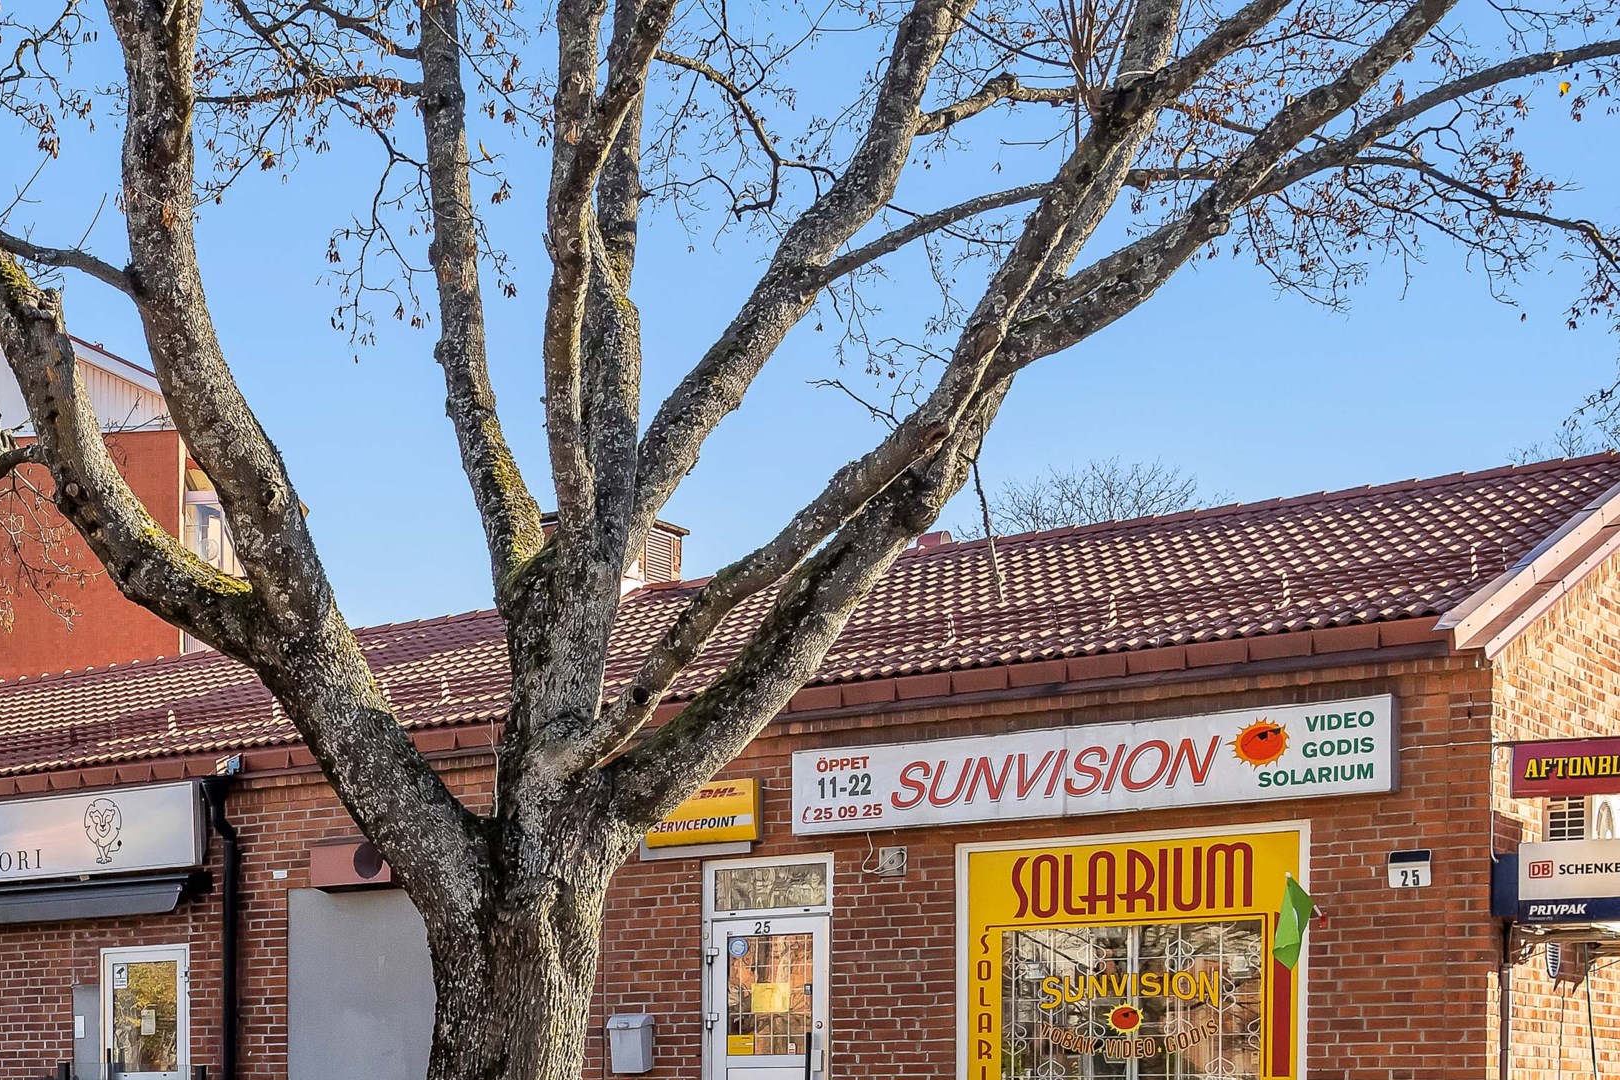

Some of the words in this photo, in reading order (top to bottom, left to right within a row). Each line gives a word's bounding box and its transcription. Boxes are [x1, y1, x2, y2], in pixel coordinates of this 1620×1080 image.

[1305, 710, 1375, 733] VIDEO
[1302, 736, 1375, 759] GODIS
[816, 755, 870, 773] ÖPPET
[890, 735, 1222, 811] SUNVISION
[1258, 762, 1374, 788] SOLARIUM
[1524, 755, 1620, 779] AFTONBL
[699, 786, 738, 800] DHL
[817, 772, 872, 799] 11-22
[813, 806, 833, 821] 25
[837, 804, 858, 820] 09
[862, 802, 883, 817] 25
[652, 815, 738, 834] SERVICEPOINT
[1010, 841, 1253, 919] SOLARIUM
[1400, 869, 1421, 887] 25
[1531, 863, 1552, 877] DB
[1558, 862, 1620, 876] SCHENKE
[1529, 903, 1588, 916] PRIVPAK
[754, 921, 771, 935] 25
[1039, 970, 1220, 1010] SUNVISION
[1040, 1020, 1097, 1057] TOBAK
[1105, 1036, 1157, 1060] VIDEO
[1164, 1018, 1220, 1055] GODIS
